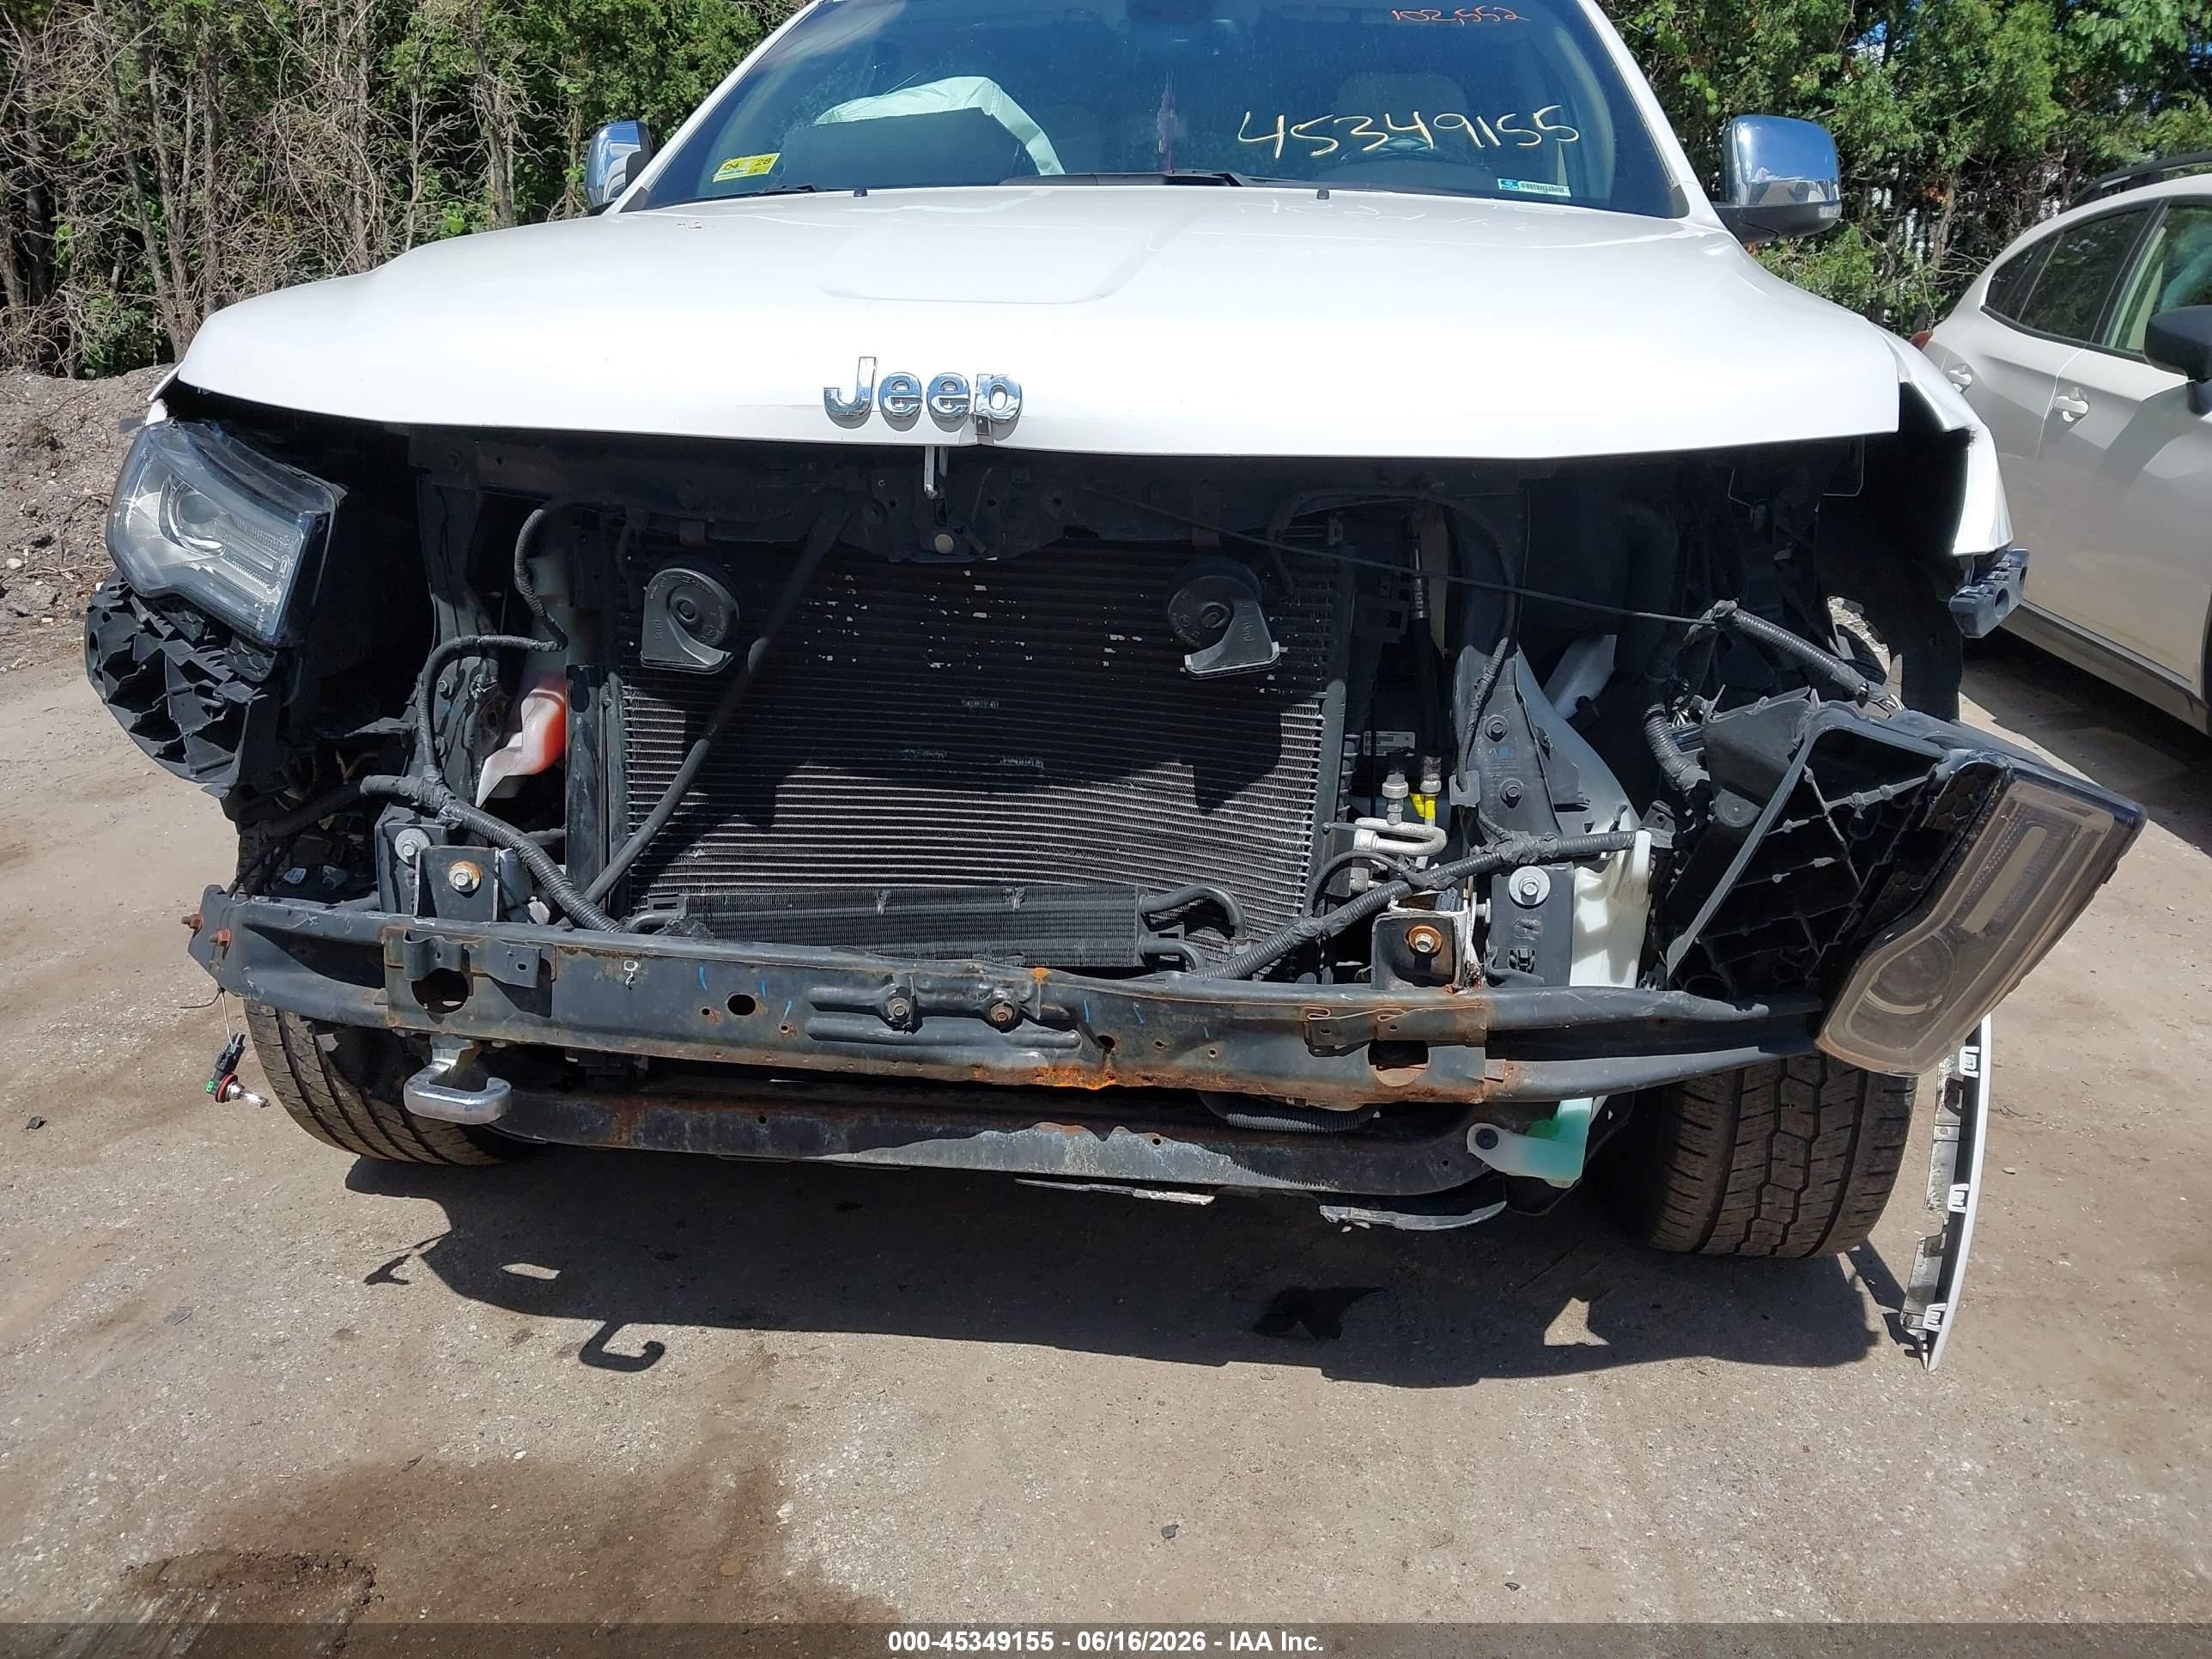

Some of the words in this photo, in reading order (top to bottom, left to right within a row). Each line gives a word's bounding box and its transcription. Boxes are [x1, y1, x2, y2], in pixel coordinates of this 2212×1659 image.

[1237, 104, 1580, 159] 45349155
[754, 157, 773, 167] 28
[823, 356, 1023, 435] Jeep
